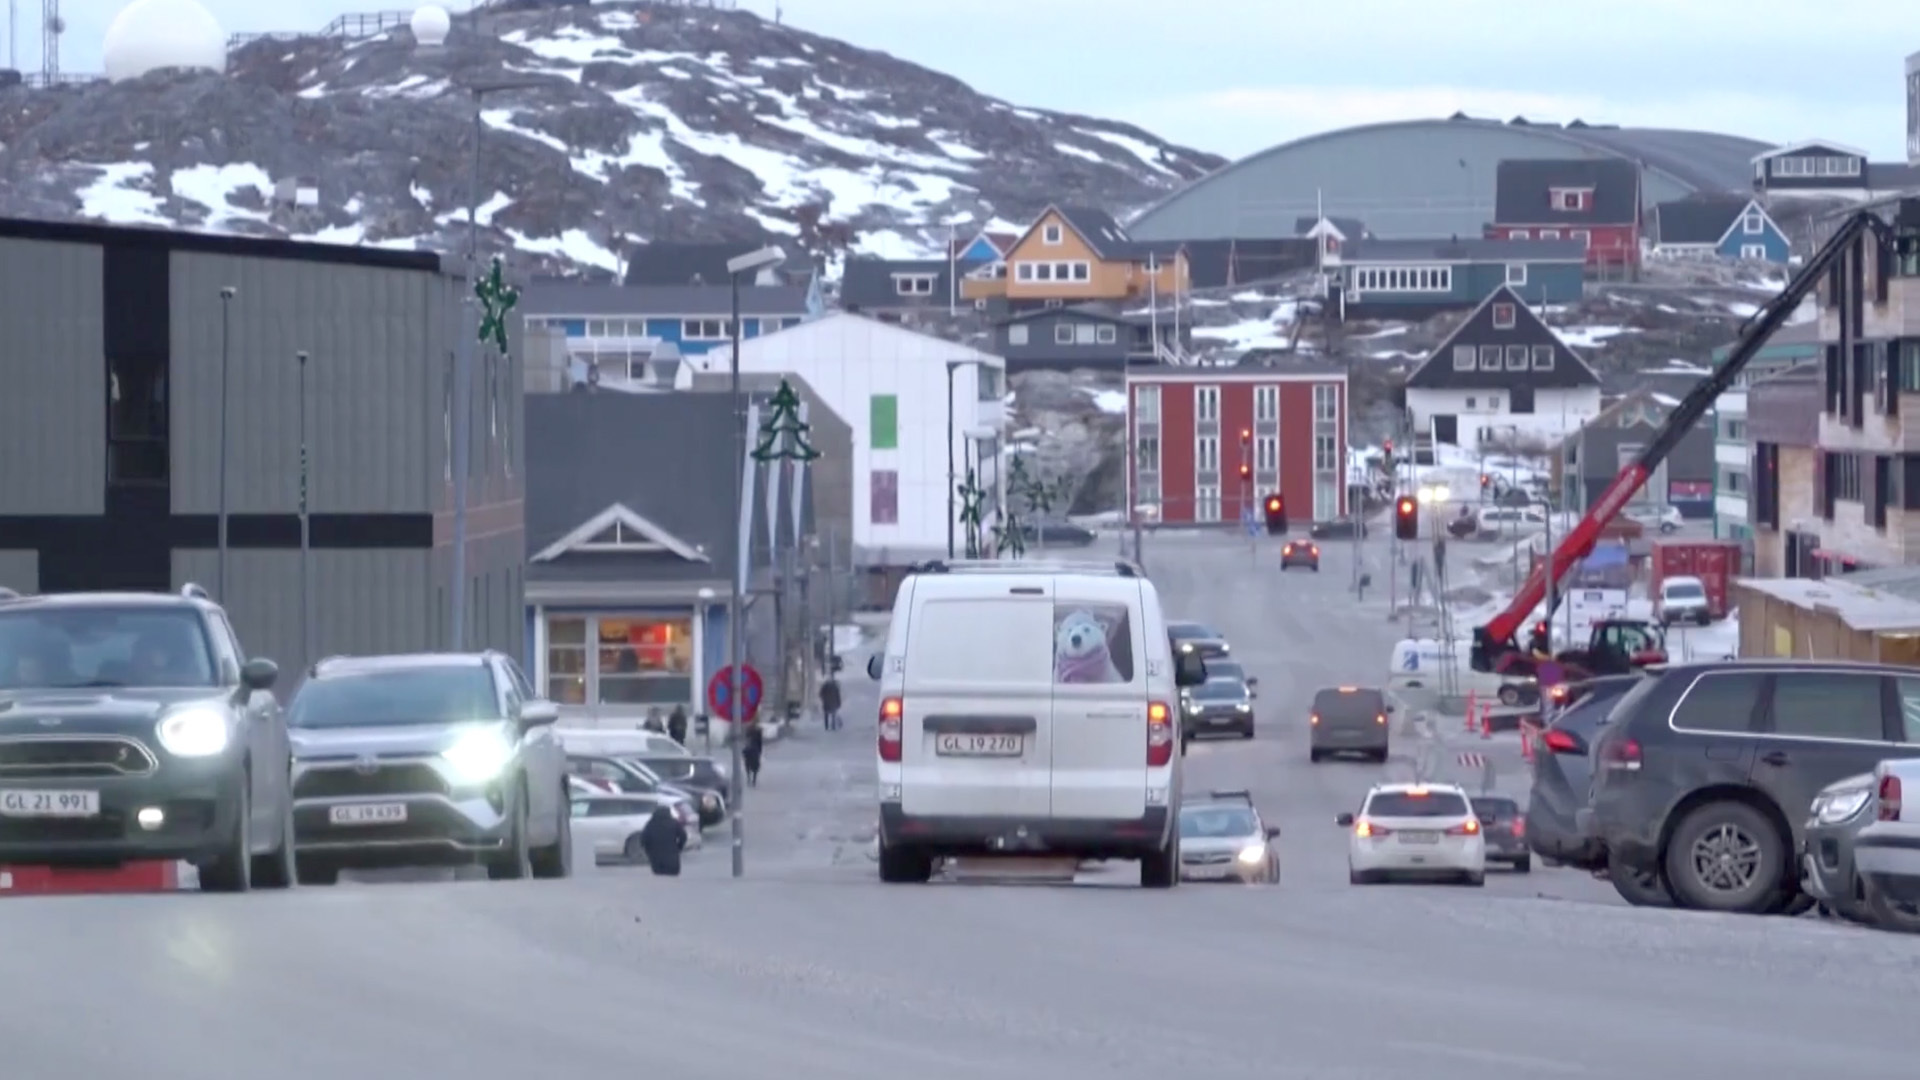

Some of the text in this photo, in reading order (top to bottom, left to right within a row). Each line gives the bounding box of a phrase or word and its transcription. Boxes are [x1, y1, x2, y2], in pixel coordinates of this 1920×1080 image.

[943, 736, 1016, 750] GL 19 270
[5, 793, 88, 810] GL 21 991
[335, 807, 351, 820] GL
